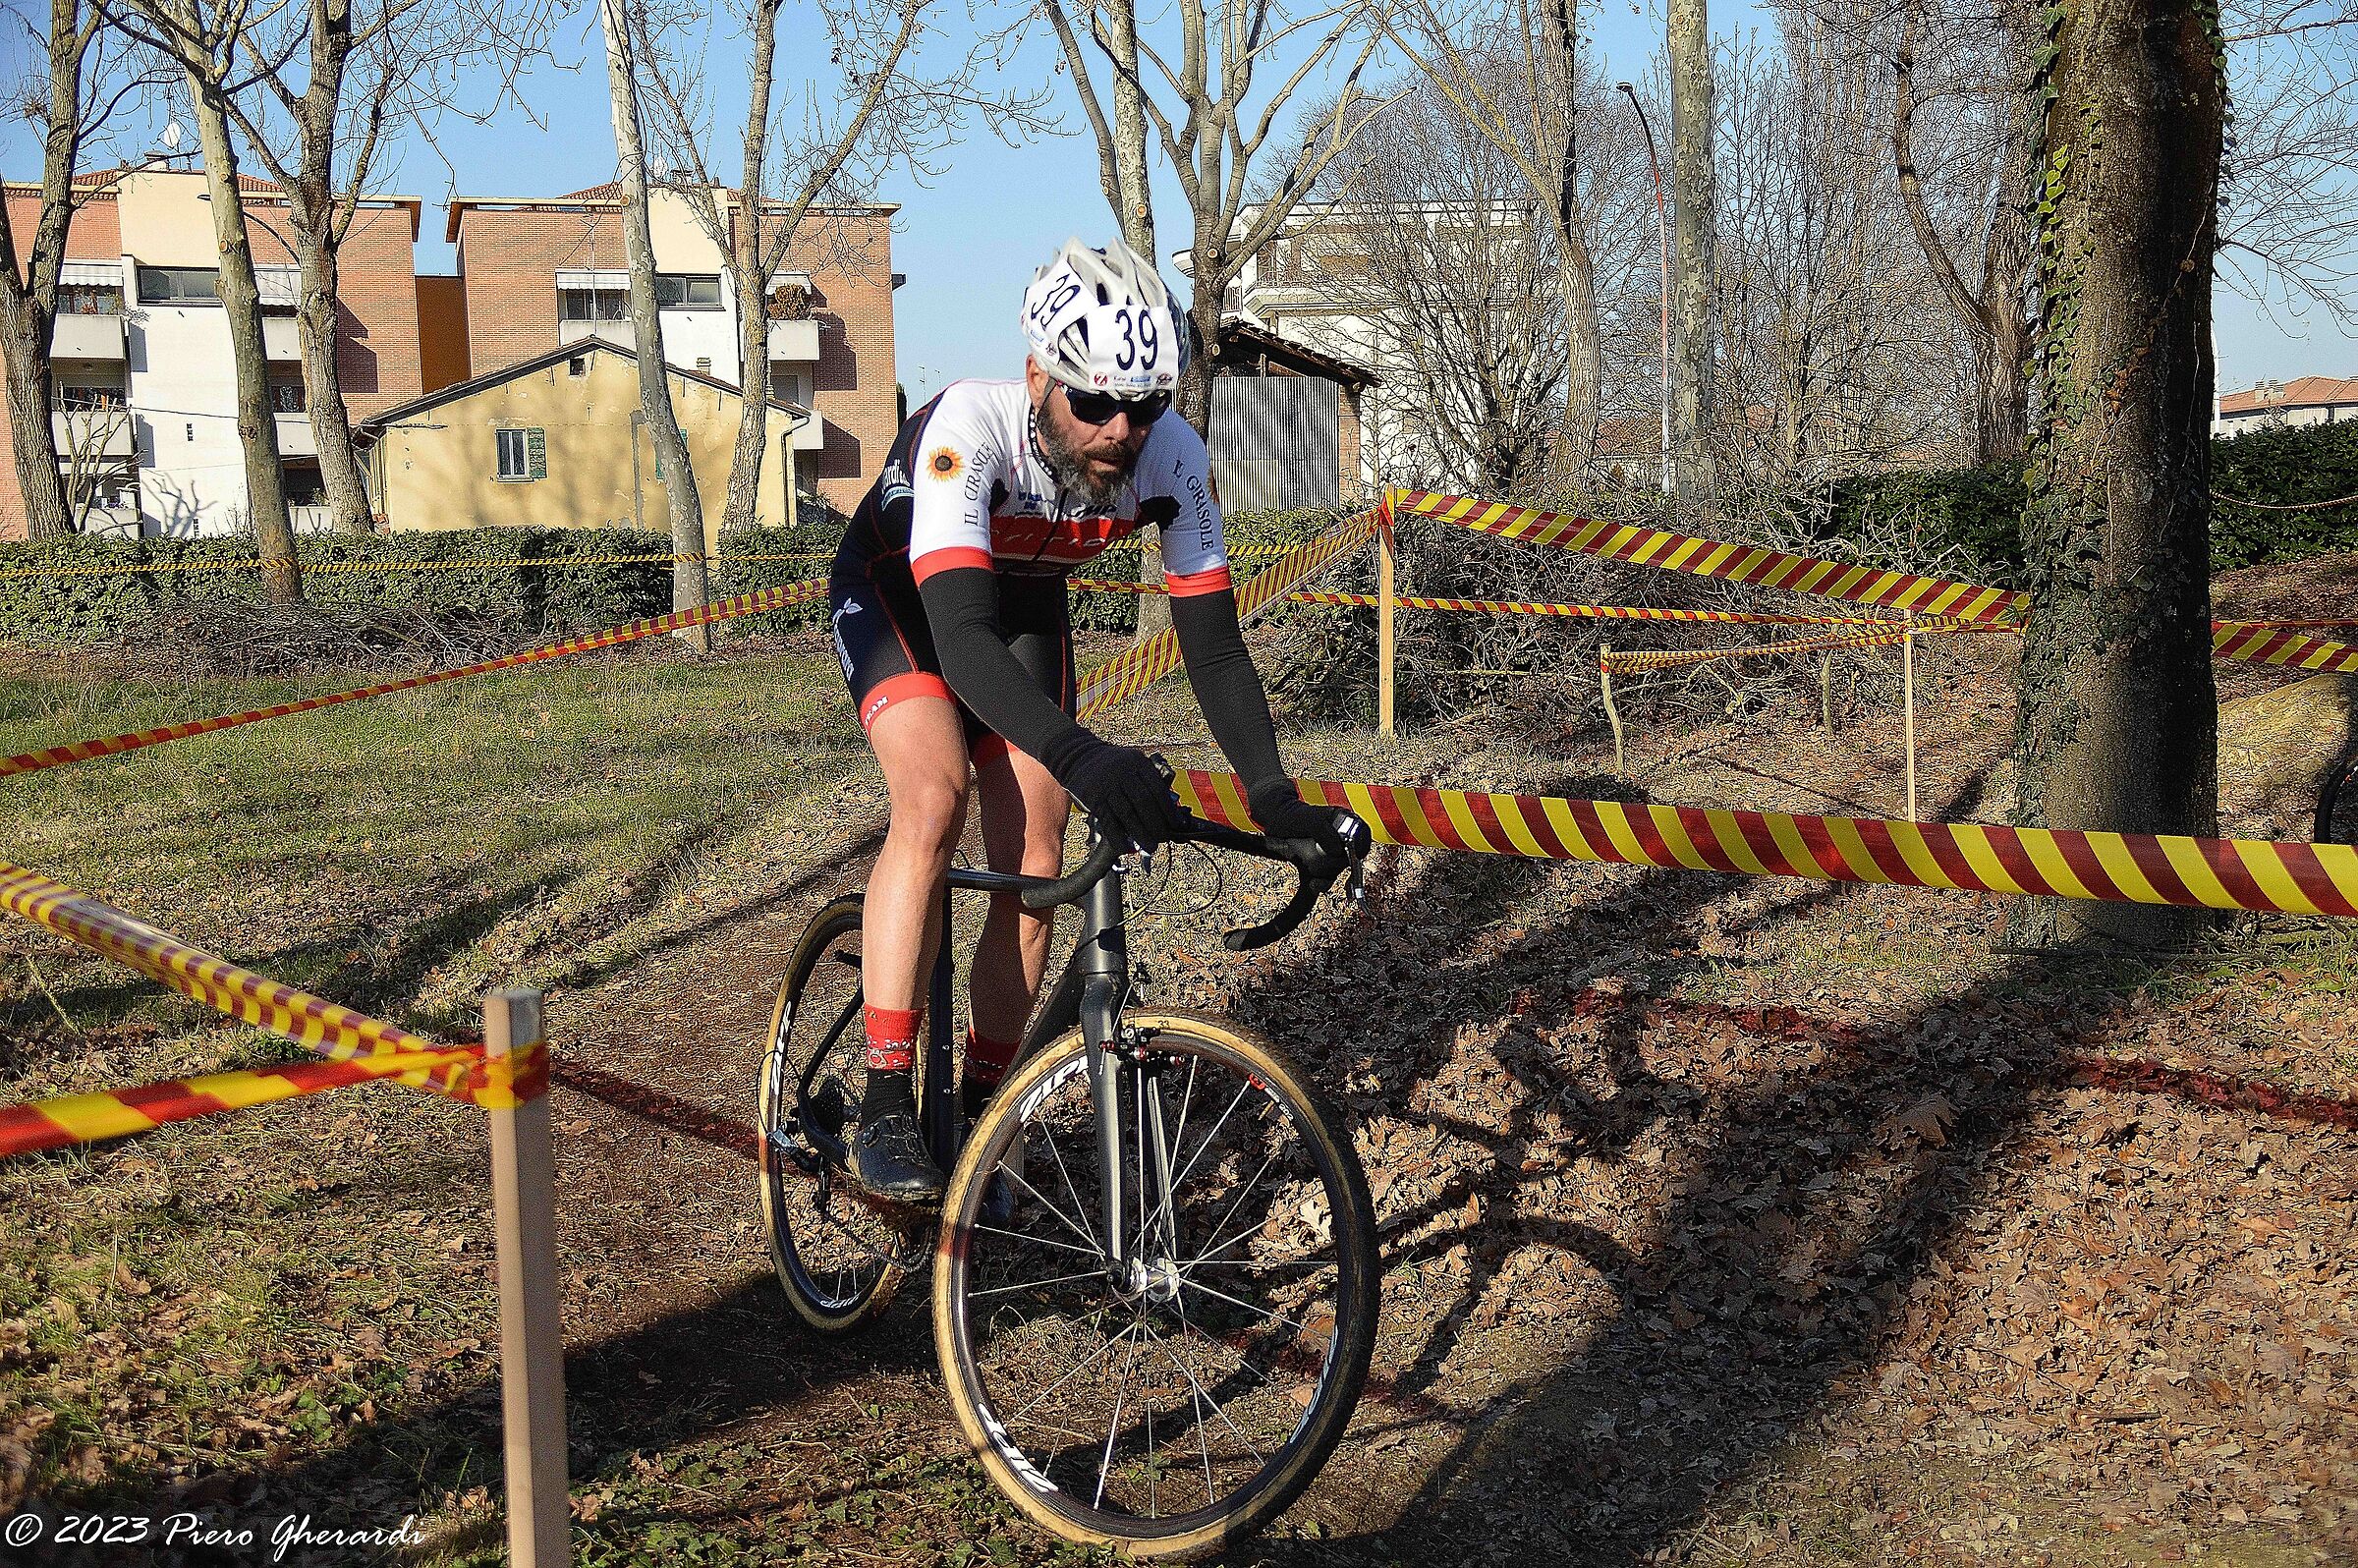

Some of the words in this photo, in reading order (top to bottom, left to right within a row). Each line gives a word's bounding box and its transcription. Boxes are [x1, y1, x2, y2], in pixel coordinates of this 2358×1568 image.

[1031, 273, 1081, 331] 39
[1115, 308, 1158, 371] 39
[964, 507, 980, 527] IL
[978, 1402, 1060, 1492] ZIPP
